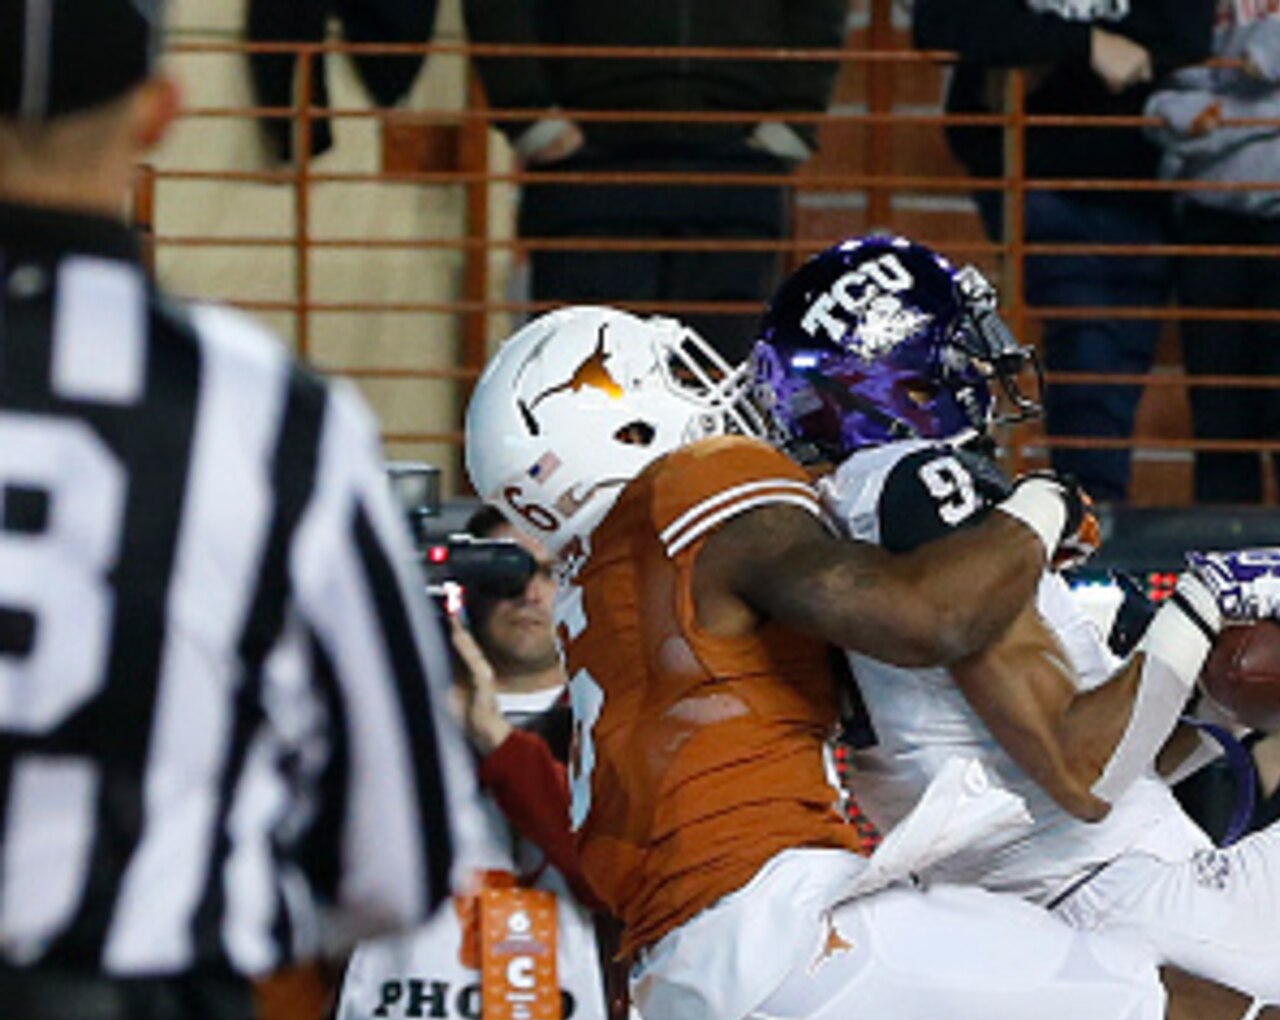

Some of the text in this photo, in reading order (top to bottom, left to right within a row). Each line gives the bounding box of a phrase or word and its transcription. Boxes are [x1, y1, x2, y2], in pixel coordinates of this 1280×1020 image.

[800, 254, 914, 343] TCU
[503, 486, 560, 531] 6
[918, 456, 977, 526] 9
[506, 956, 536, 989] C
